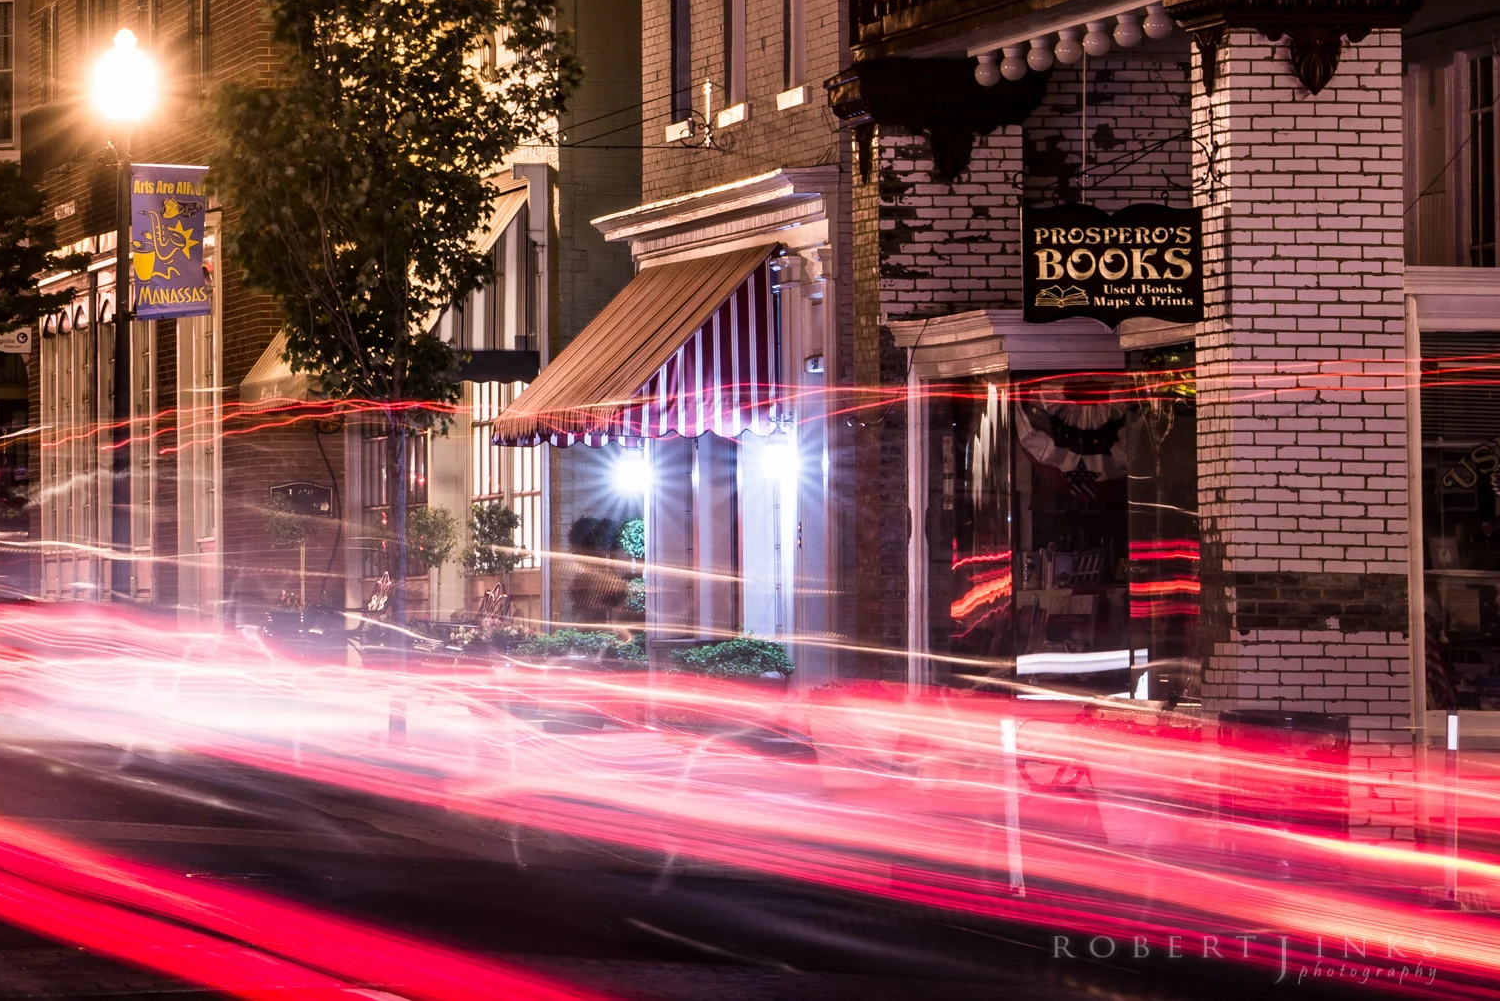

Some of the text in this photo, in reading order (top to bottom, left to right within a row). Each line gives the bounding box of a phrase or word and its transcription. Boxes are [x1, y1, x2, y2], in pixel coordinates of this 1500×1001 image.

[133, 179, 155, 195] Arts
[156, 180, 175, 195] Are
[1033, 226, 1192, 245] PROSPERO'S
[1033, 247, 1193, 281] BOOKS
[138, 285, 208, 306] MANASSAS
[1103, 283, 1183, 295] Used Books
[1093, 296, 1194, 309] Maps & Prints
[1443, 436, 1500, 491] US
